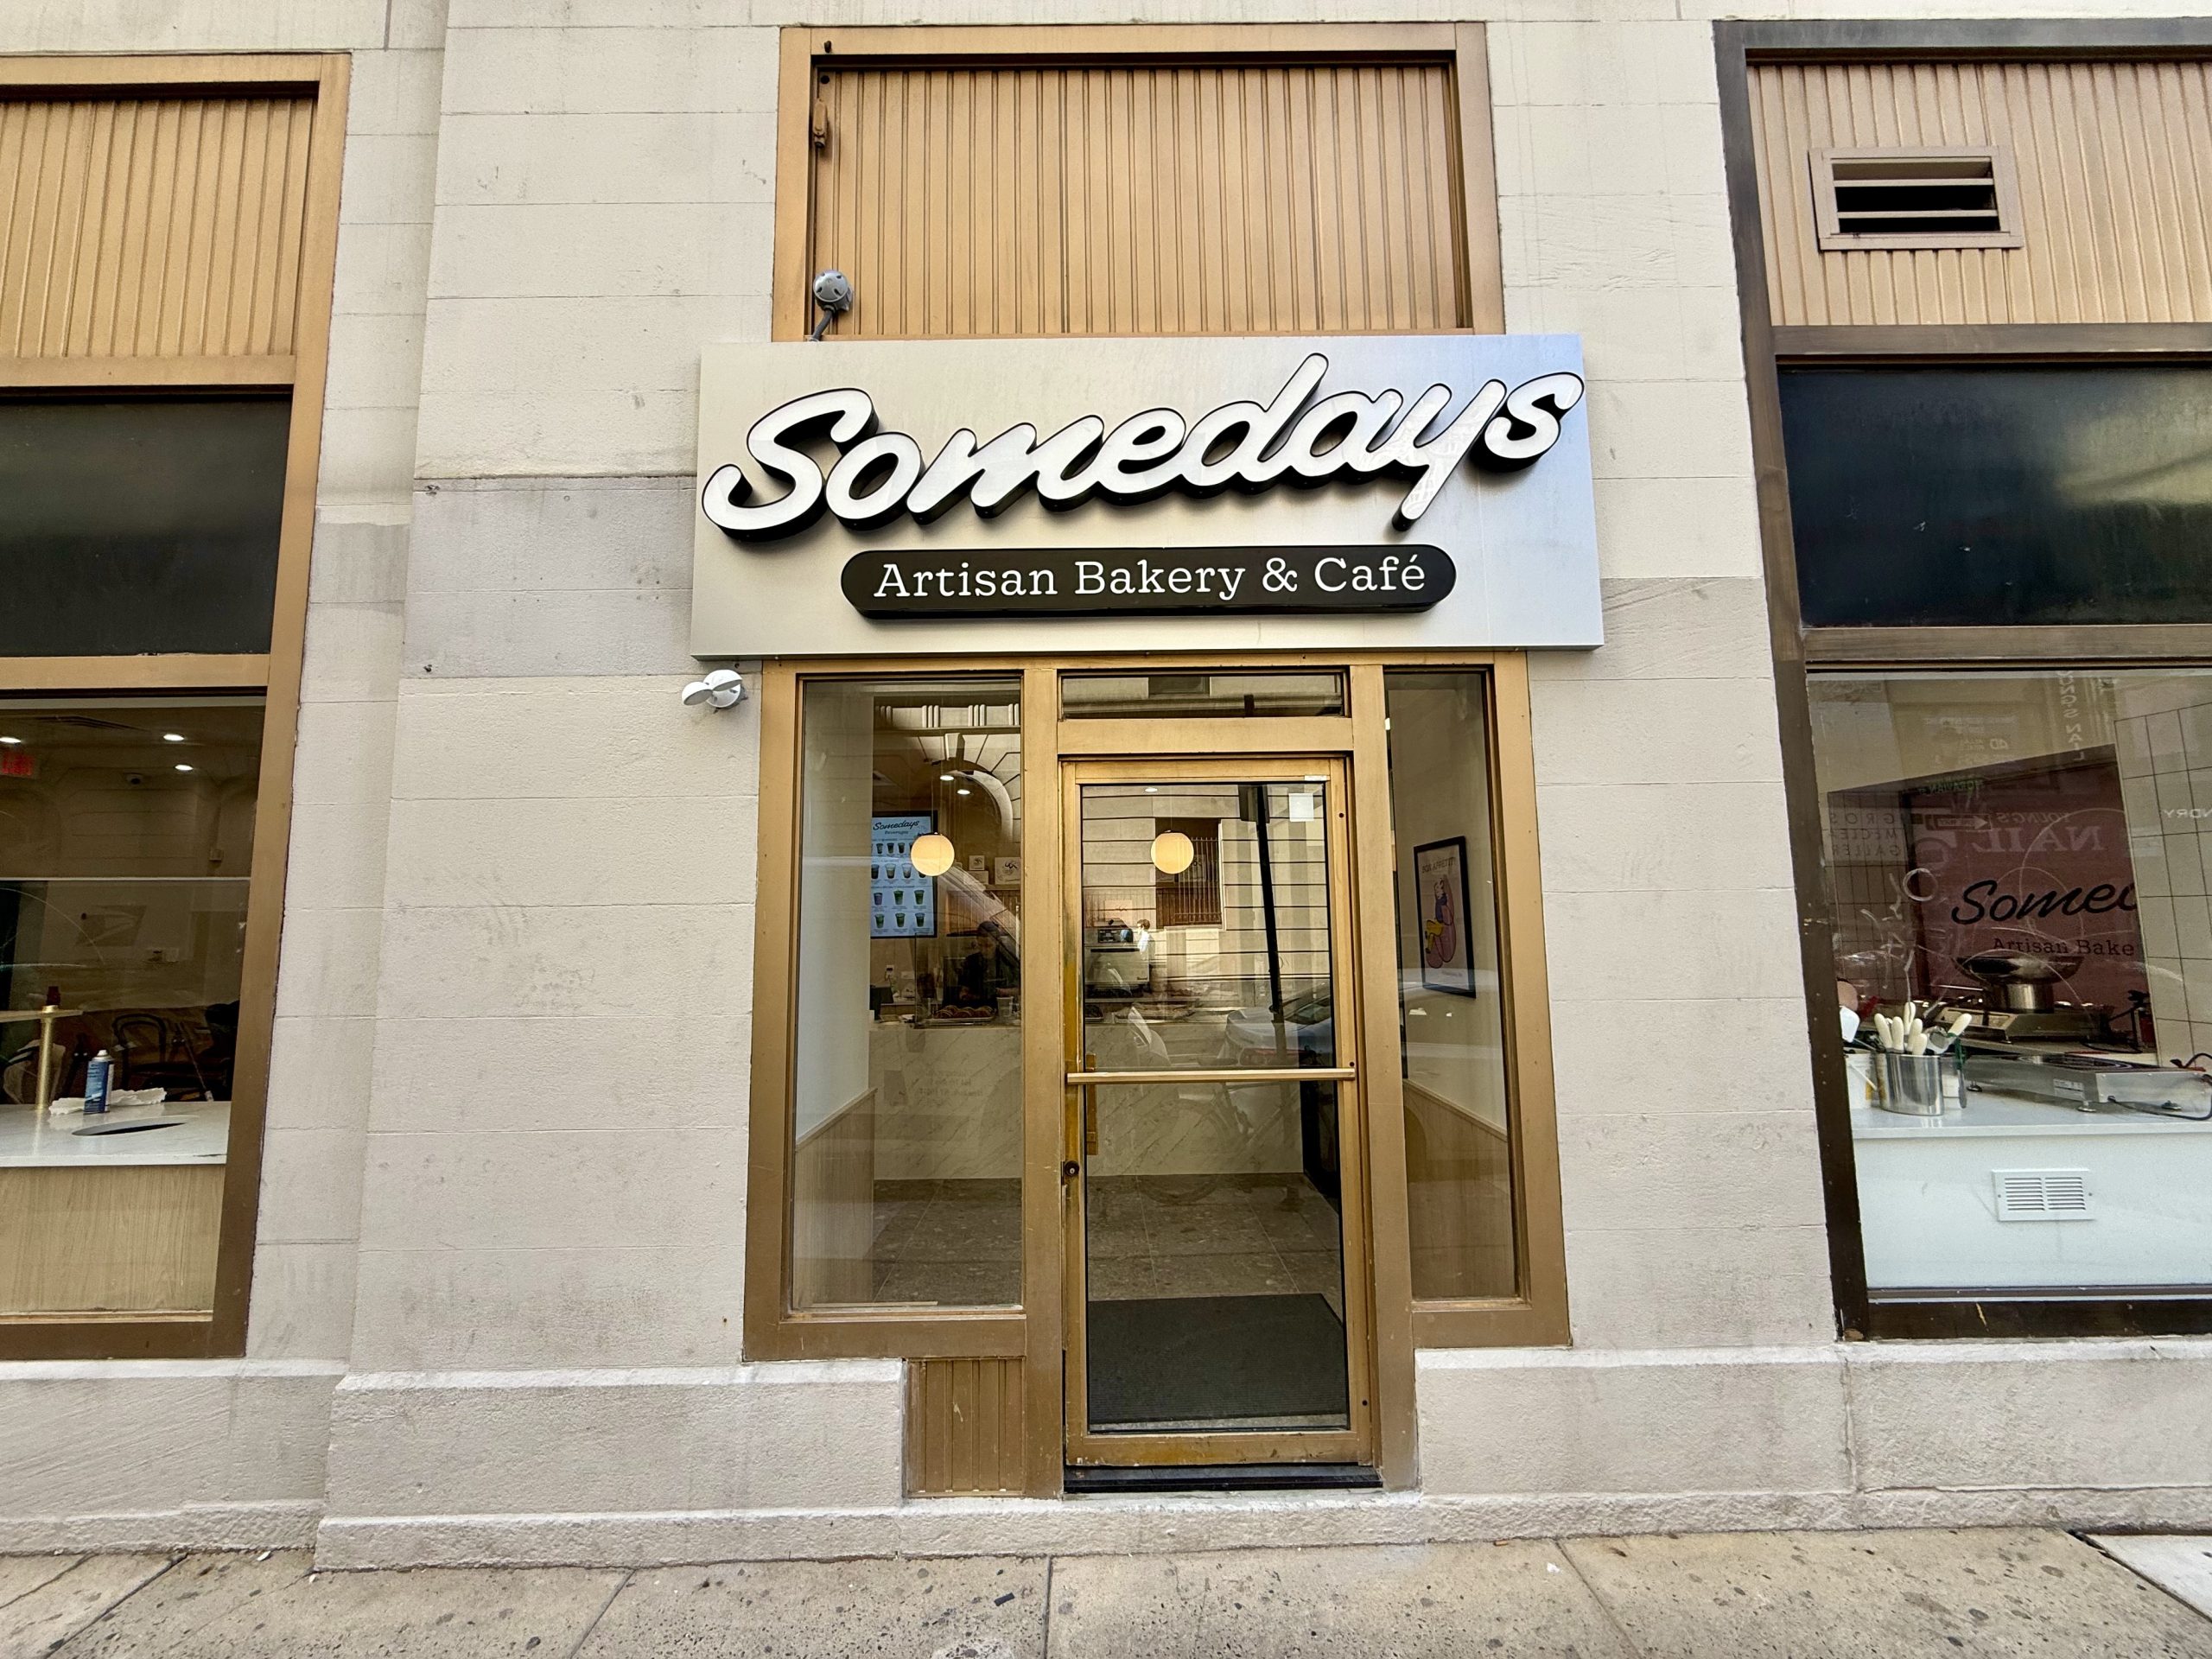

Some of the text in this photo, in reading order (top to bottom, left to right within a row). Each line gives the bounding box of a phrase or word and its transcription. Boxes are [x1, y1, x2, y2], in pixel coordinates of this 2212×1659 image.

[701, 353, 1585, 534] Somedays
[873, 554, 1427, 601] Artisan Bakery & Café
[873, 820, 920, 830] Somedays
[1992, 937, 2069, 955] Artisan
